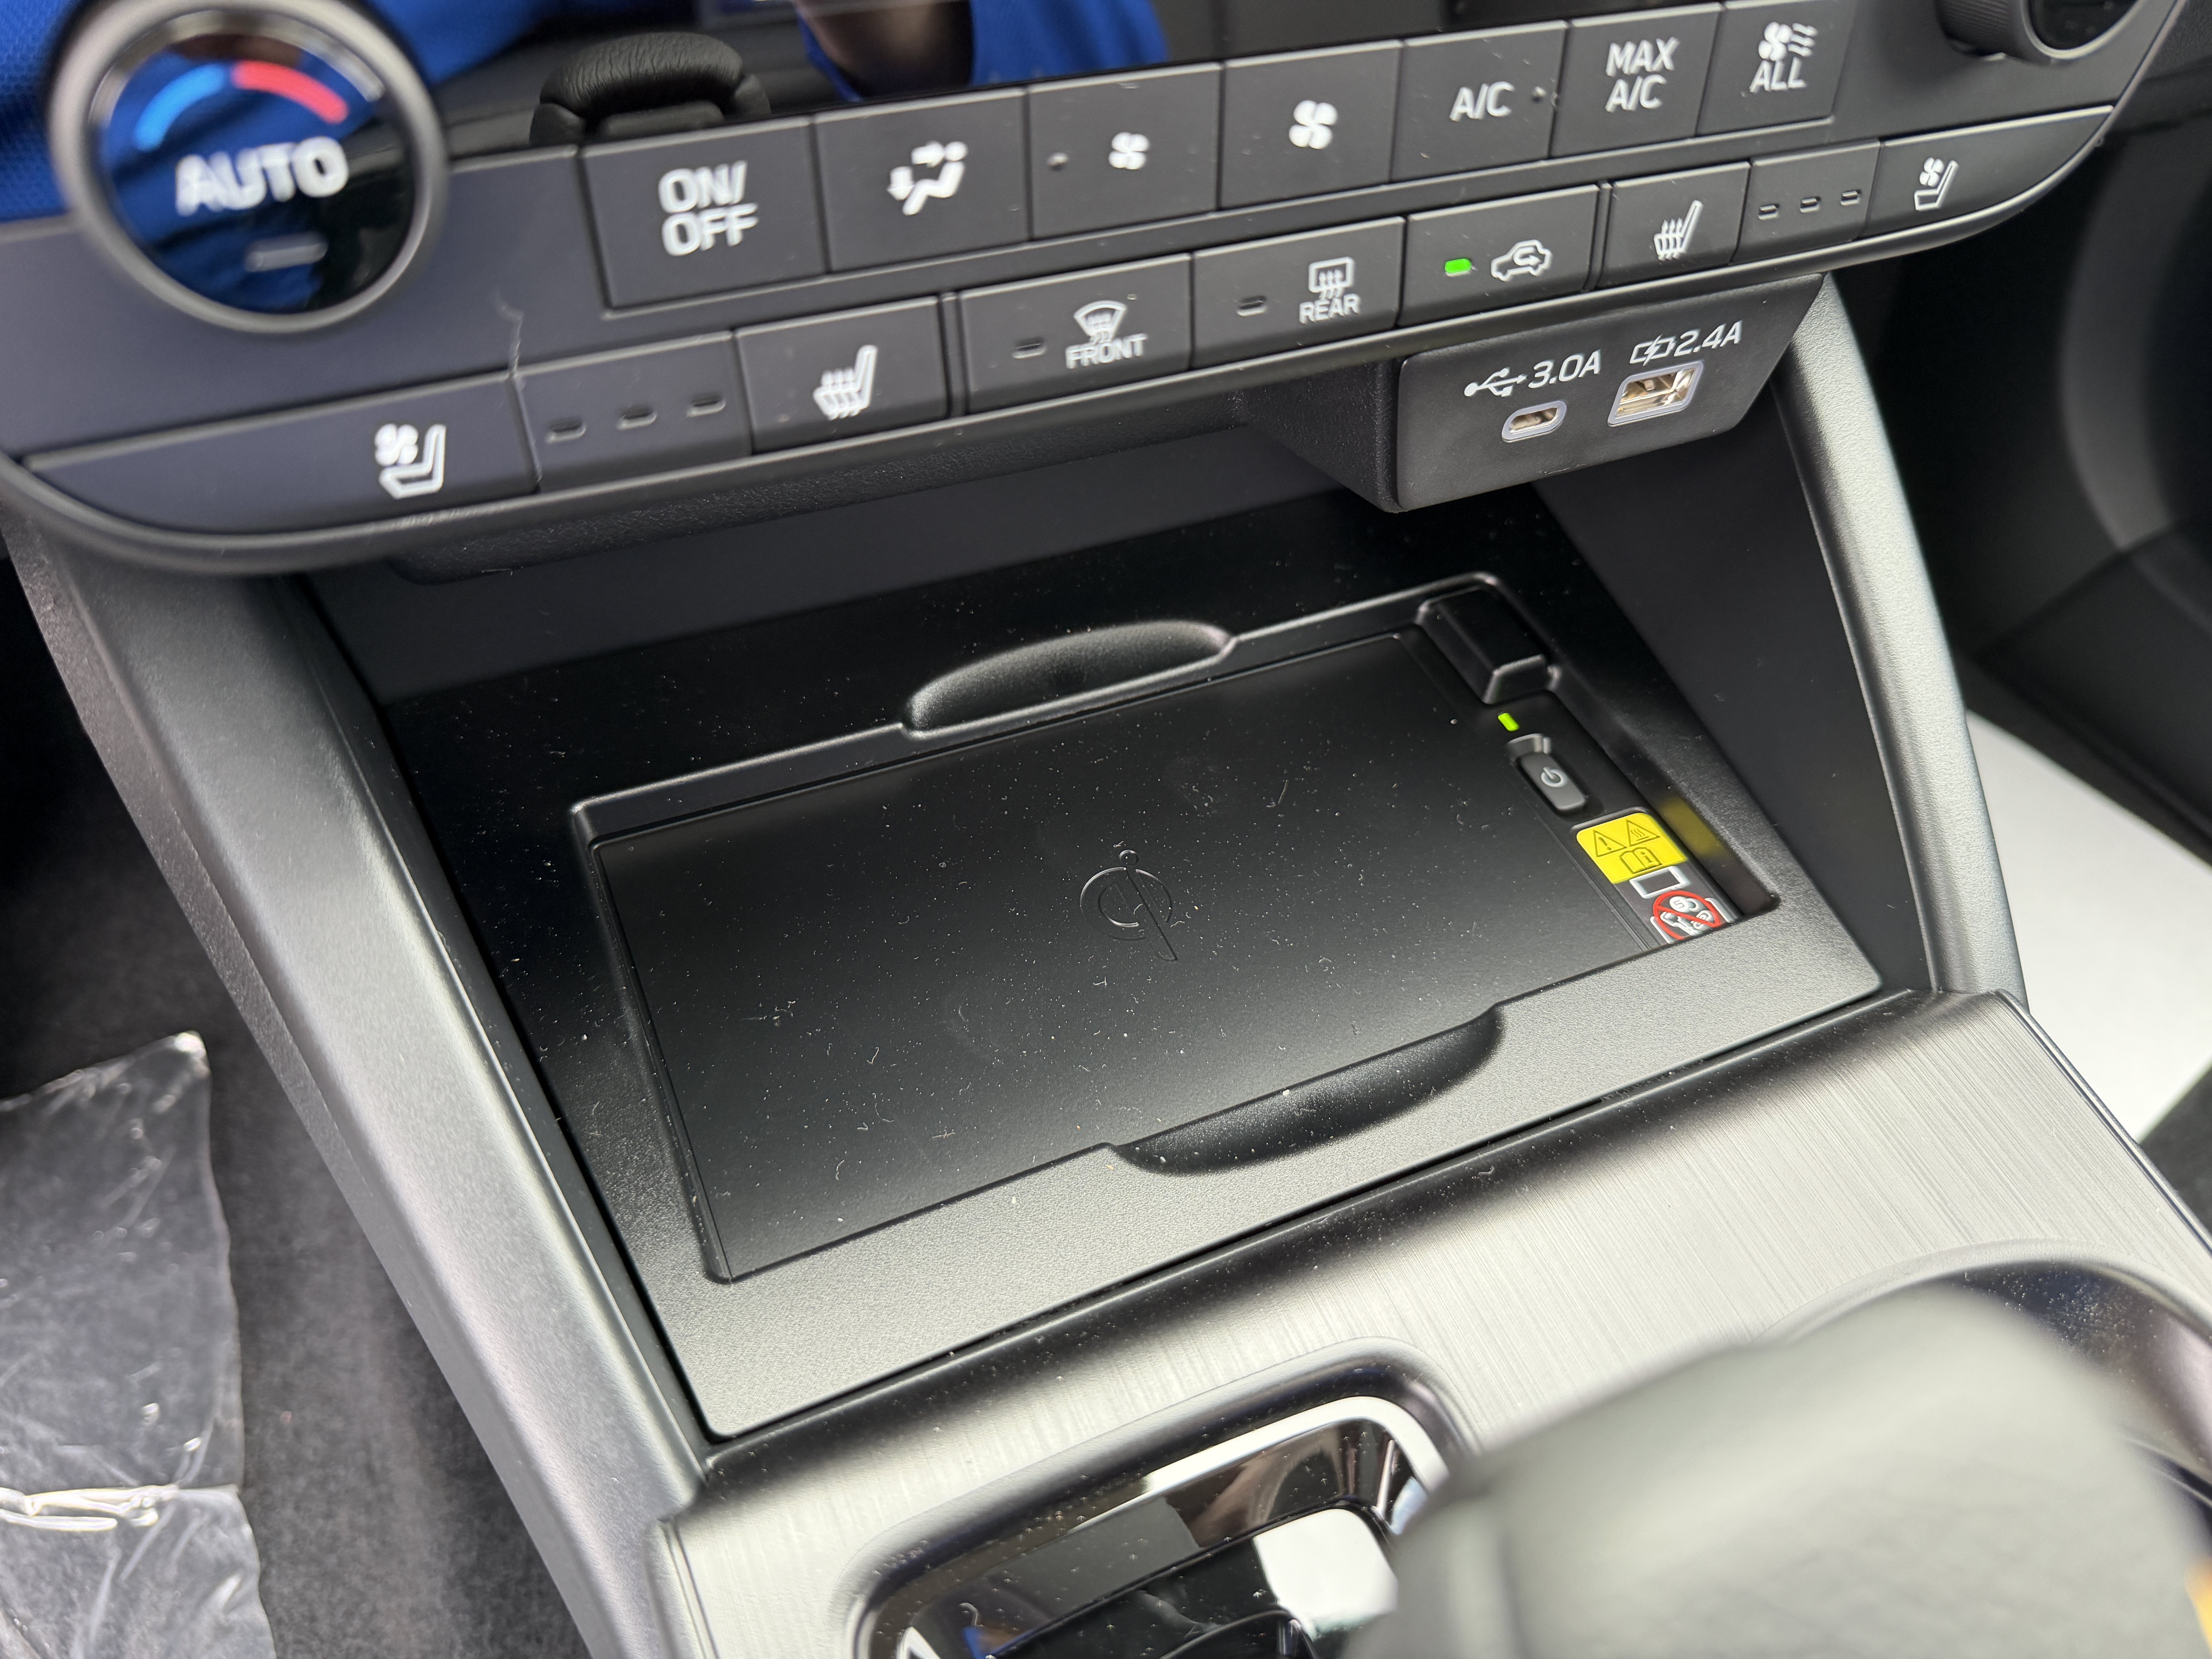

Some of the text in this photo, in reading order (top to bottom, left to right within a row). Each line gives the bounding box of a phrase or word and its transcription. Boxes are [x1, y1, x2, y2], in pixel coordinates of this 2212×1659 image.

[1606, 36, 1680, 77] MAX
[1749, 57, 1808, 93] ALL
[1449, 81, 1515, 122] A/C
[1605, 74, 1667, 113] A/C
[175, 136, 349, 216] AUTO
[658, 160, 748, 214] ON/
[662, 203, 759, 256] OFF
[1299, 293, 1362, 325] REAR
[1065, 333, 1148, 369] FRONT
[1673, 320, 1743, 357] 2.4A
[1527, 349, 1602, 389] 3.0A
